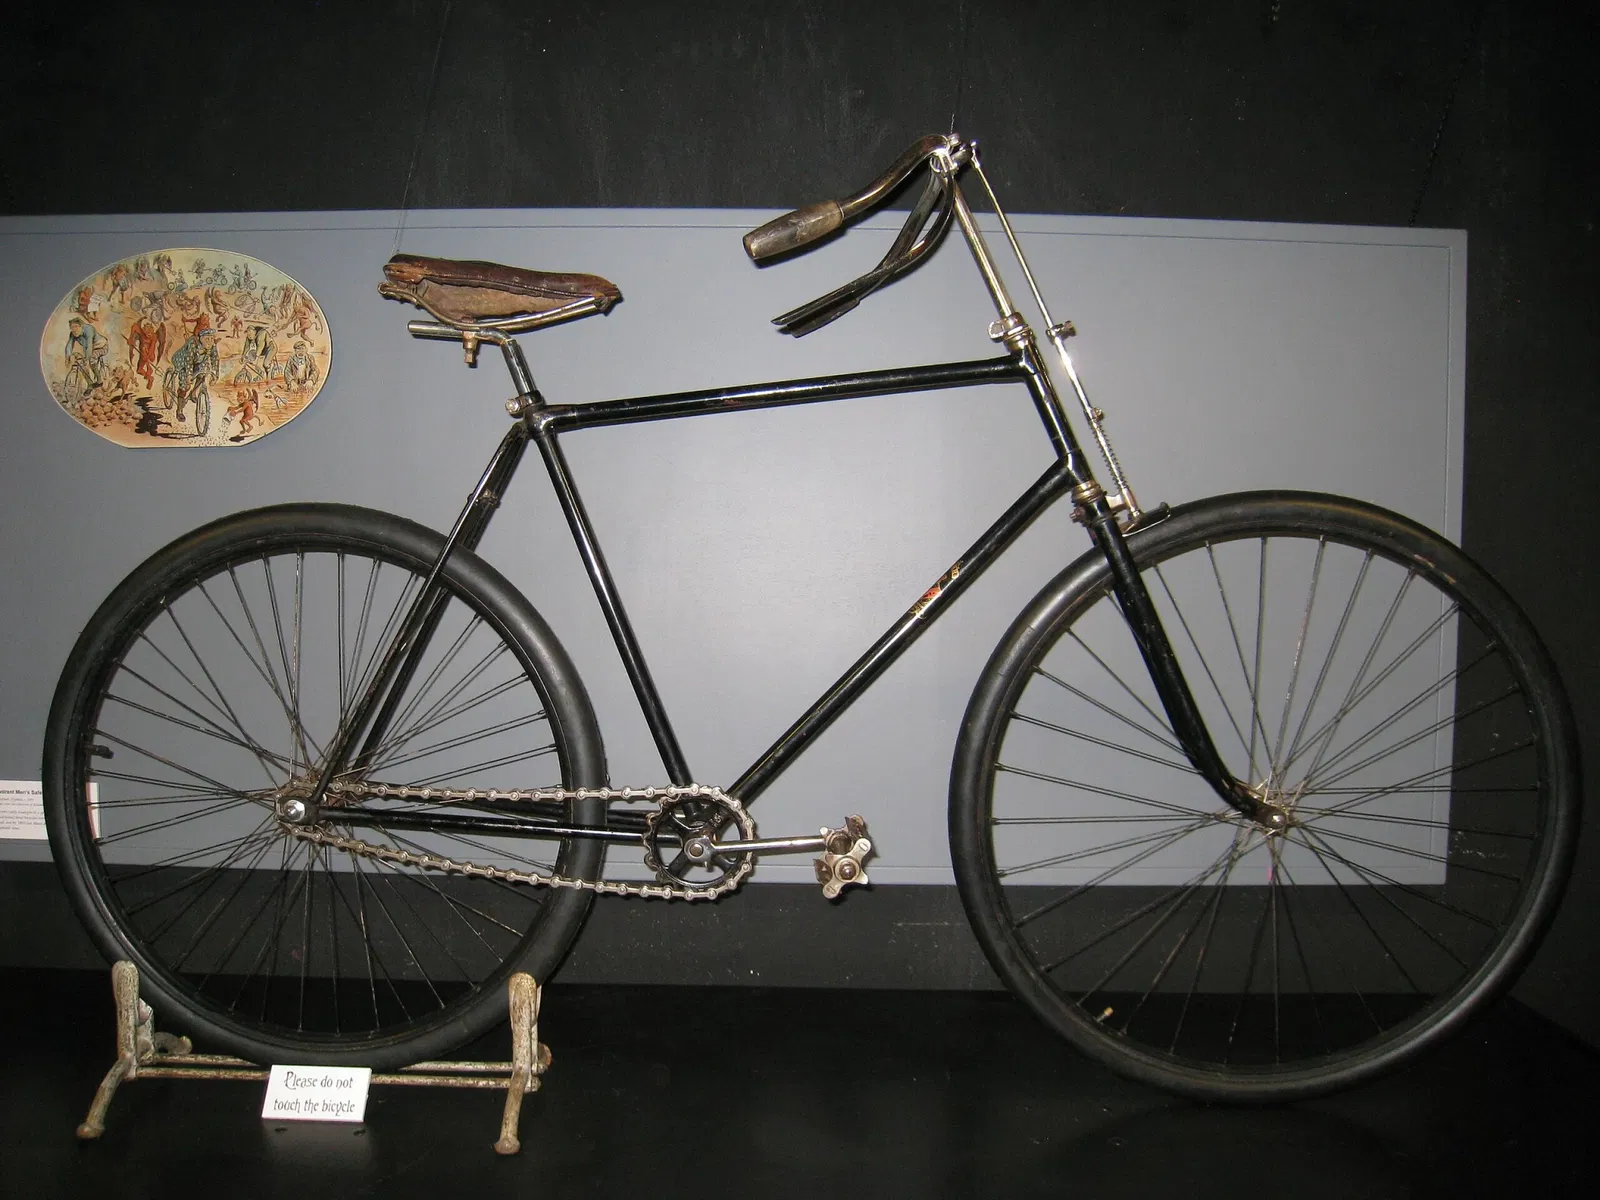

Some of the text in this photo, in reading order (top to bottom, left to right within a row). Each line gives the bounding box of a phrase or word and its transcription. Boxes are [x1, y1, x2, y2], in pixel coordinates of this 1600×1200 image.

[284, 1070, 353, 1090] Please do not
[273, 1098, 355, 1117] touch the bicycle
